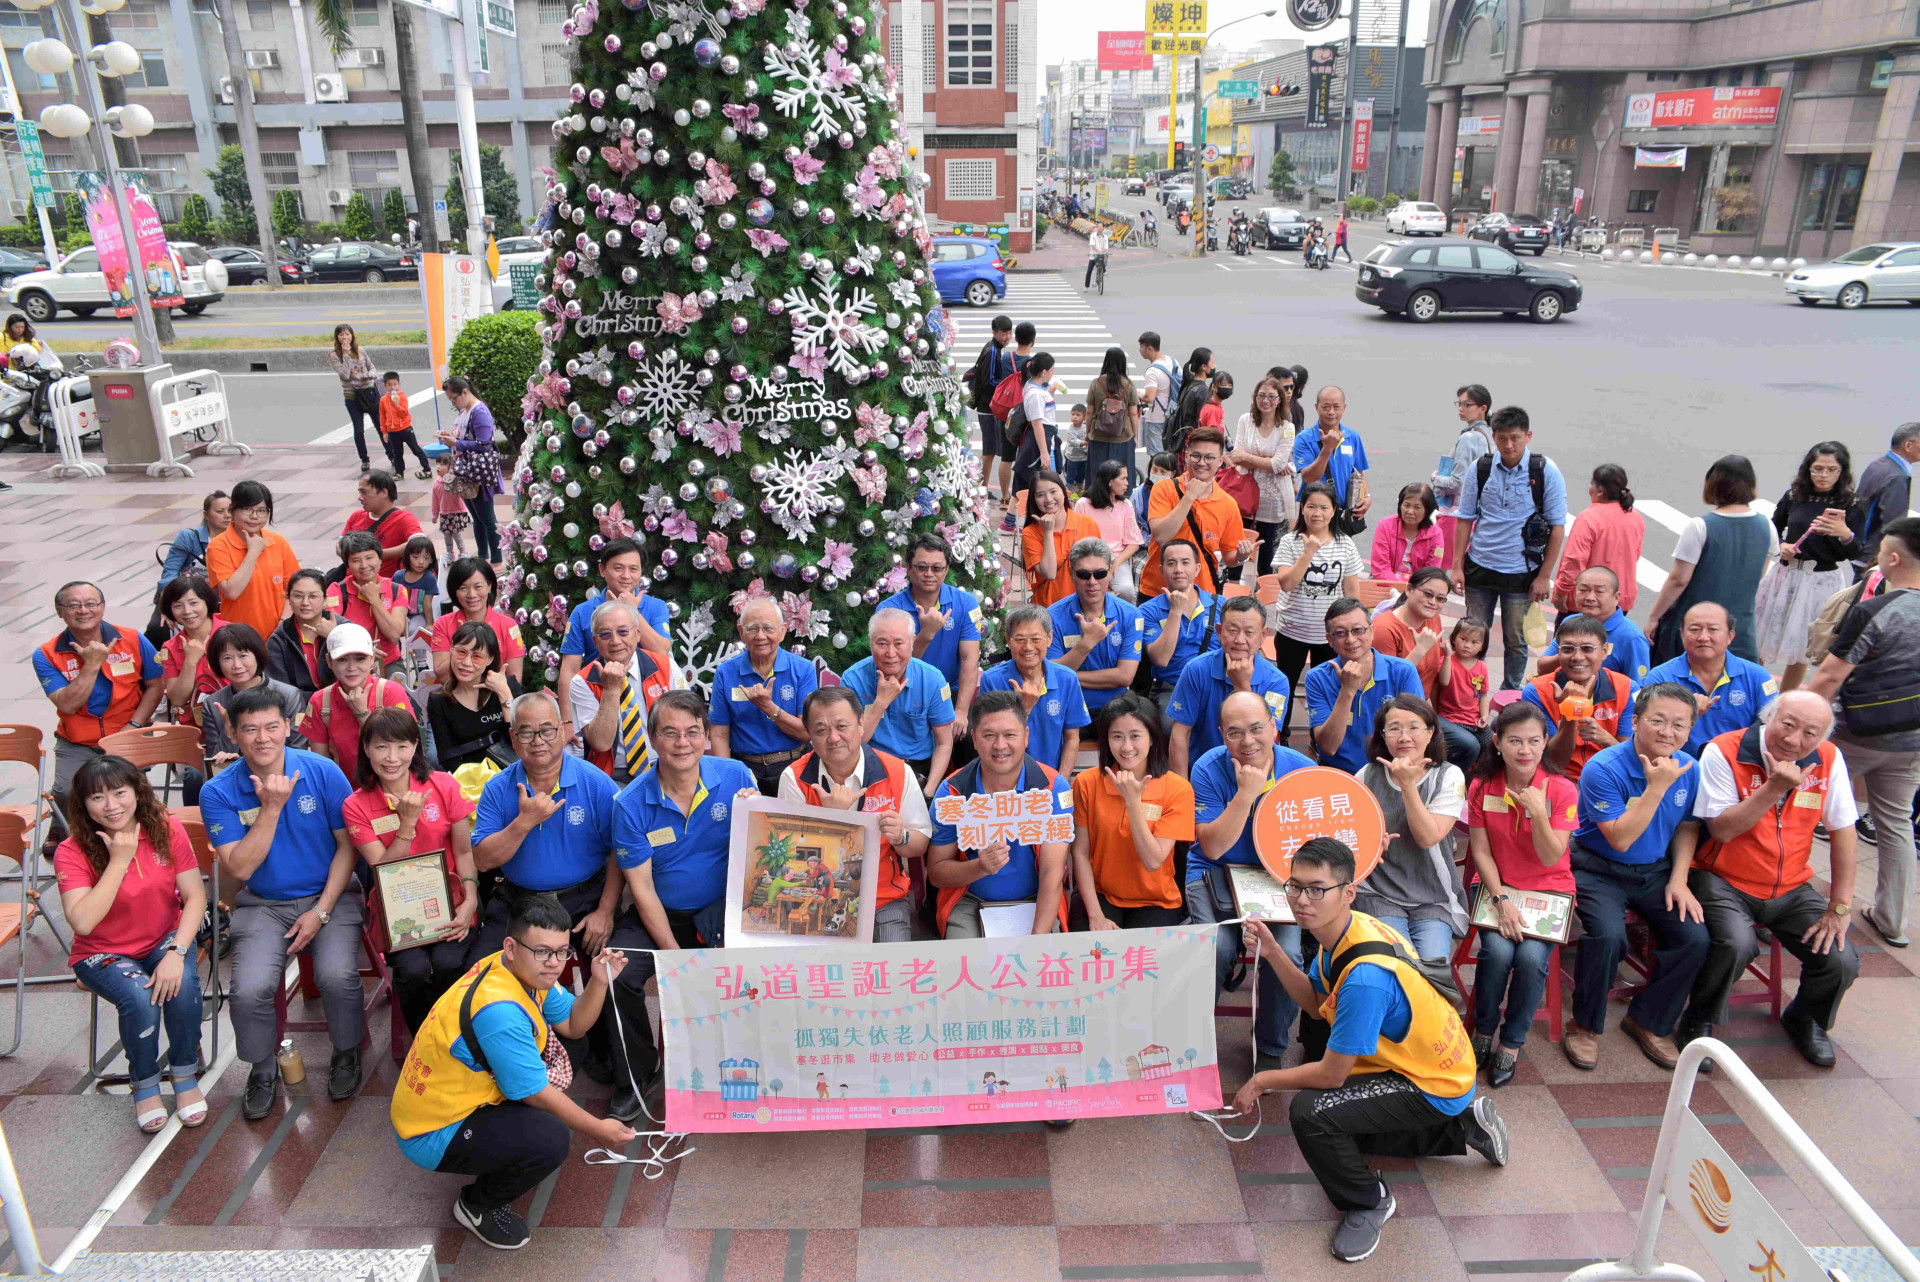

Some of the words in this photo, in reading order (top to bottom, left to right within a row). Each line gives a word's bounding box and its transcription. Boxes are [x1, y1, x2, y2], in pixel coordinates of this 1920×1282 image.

[1153, 2, 1202, 24] 燦坤
[1151, 38, 1202, 52] 歡迎光臨
[1655, 99, 1695, 118] 新光銀行
[1713, 105, 1742, 119] atm
[1355, 122, 1367, 164] 新光銀行
[746, 374, 825, 402] Merry
[723, 396, 852, 426] Christmas
[937, 793, 1050, 822] 寒冬助老
[1275, 793, 1353, 824] 從看見
[960, 817, 1072, 848] 刻不容緩
[1279, 822, 1321, 831] Change
[714, 945, 1159, 1001] 弘道聖誕老人公益市集
[794, 1015, 1086, 1048] 孤獨失依老人照顧服務計劃
[796, 1053, 856, 1065] 寒冬逛市集
[869, 1051, 930, 1063] 助老做愛心
[938, 1049, 955, 1059] 公益
[968, 1047, 986, 1057] 手作
[1030, 1044, 1048, 1054] 甜點
[1061, 1043, 1079, 1053] 美食
[1053, 1098, 1081, 1107] PACIFIC
[732, 1111, 755, 1121] Rotary
